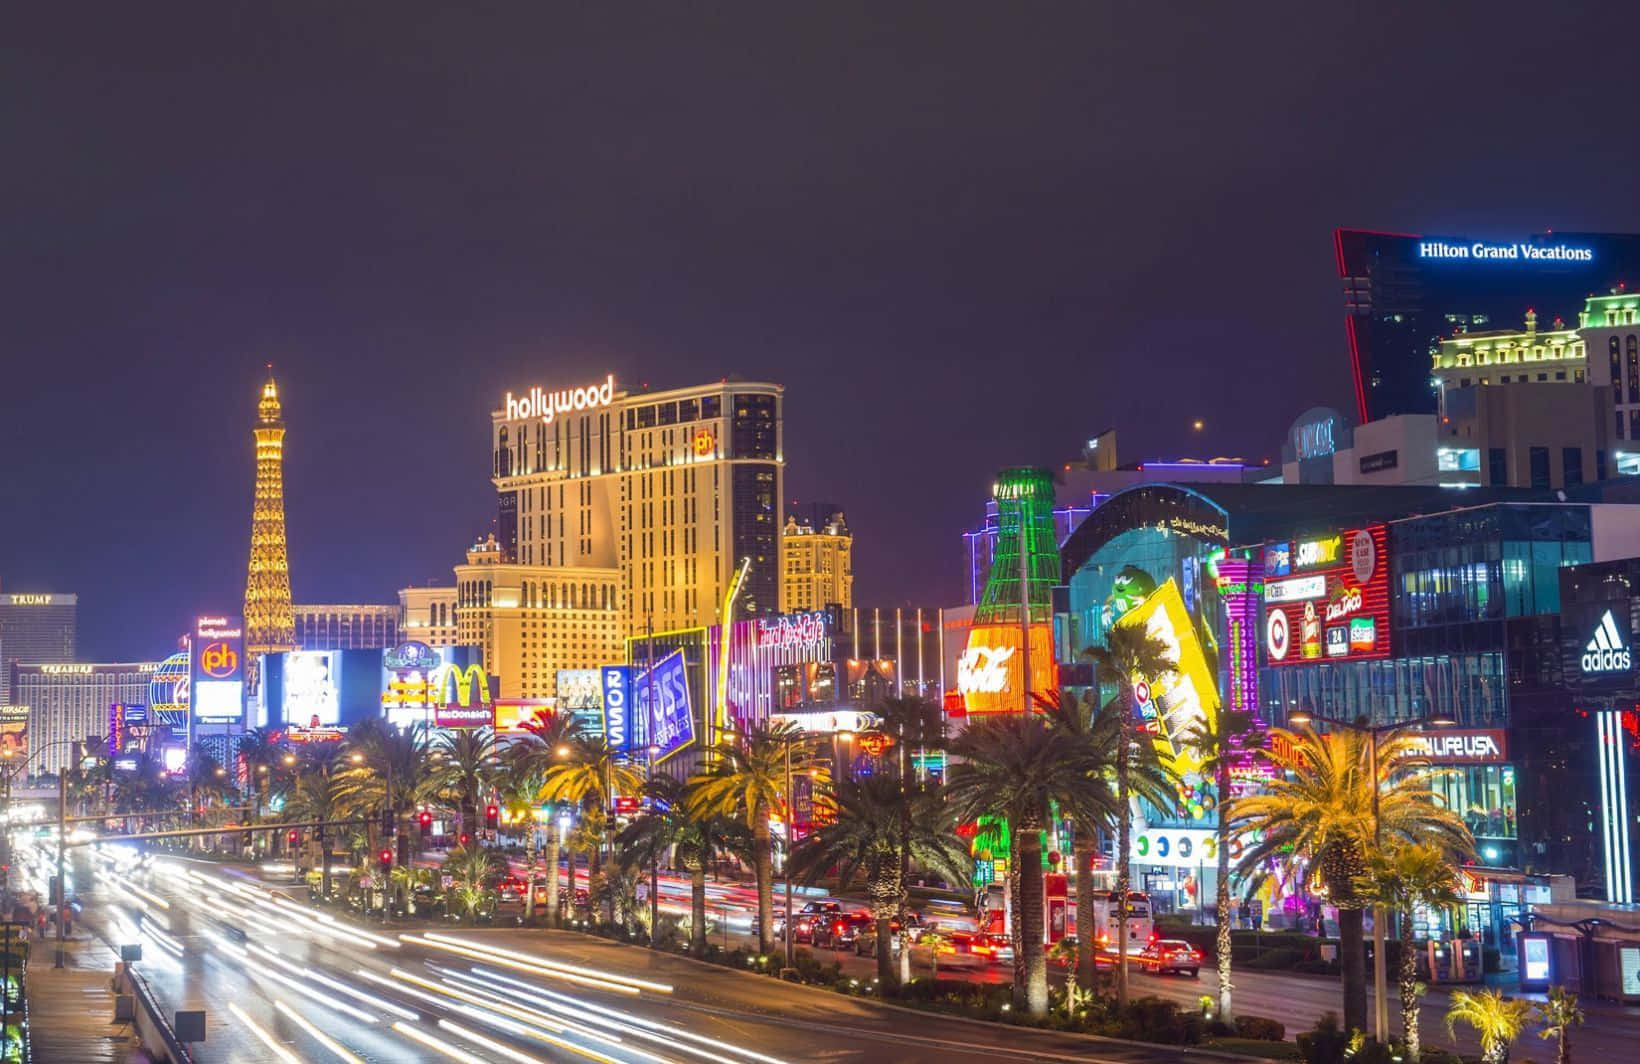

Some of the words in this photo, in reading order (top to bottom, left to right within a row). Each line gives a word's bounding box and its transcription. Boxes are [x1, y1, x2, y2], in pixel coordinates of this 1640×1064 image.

[1420, 243, 1469, 258] Hilton
[1472, 243, 1518, 259] Grand
[1520, 244, 1593, 261] Vacations
[506, 375, 614, 424] hollywood
[1296, 536, 1341, 567] SUBWAY
[11, 594, 51, 604] TRUMP
[198, 628, 241, 640] hollywood
[205, 642, 238, 672] ph
[1582, 648, 1631, 672] adidas
[41, 665, 93, 674] TREASURE
[437, 710, 492, 719] McDonald's
[606, 670, 624, 746] ROSS
